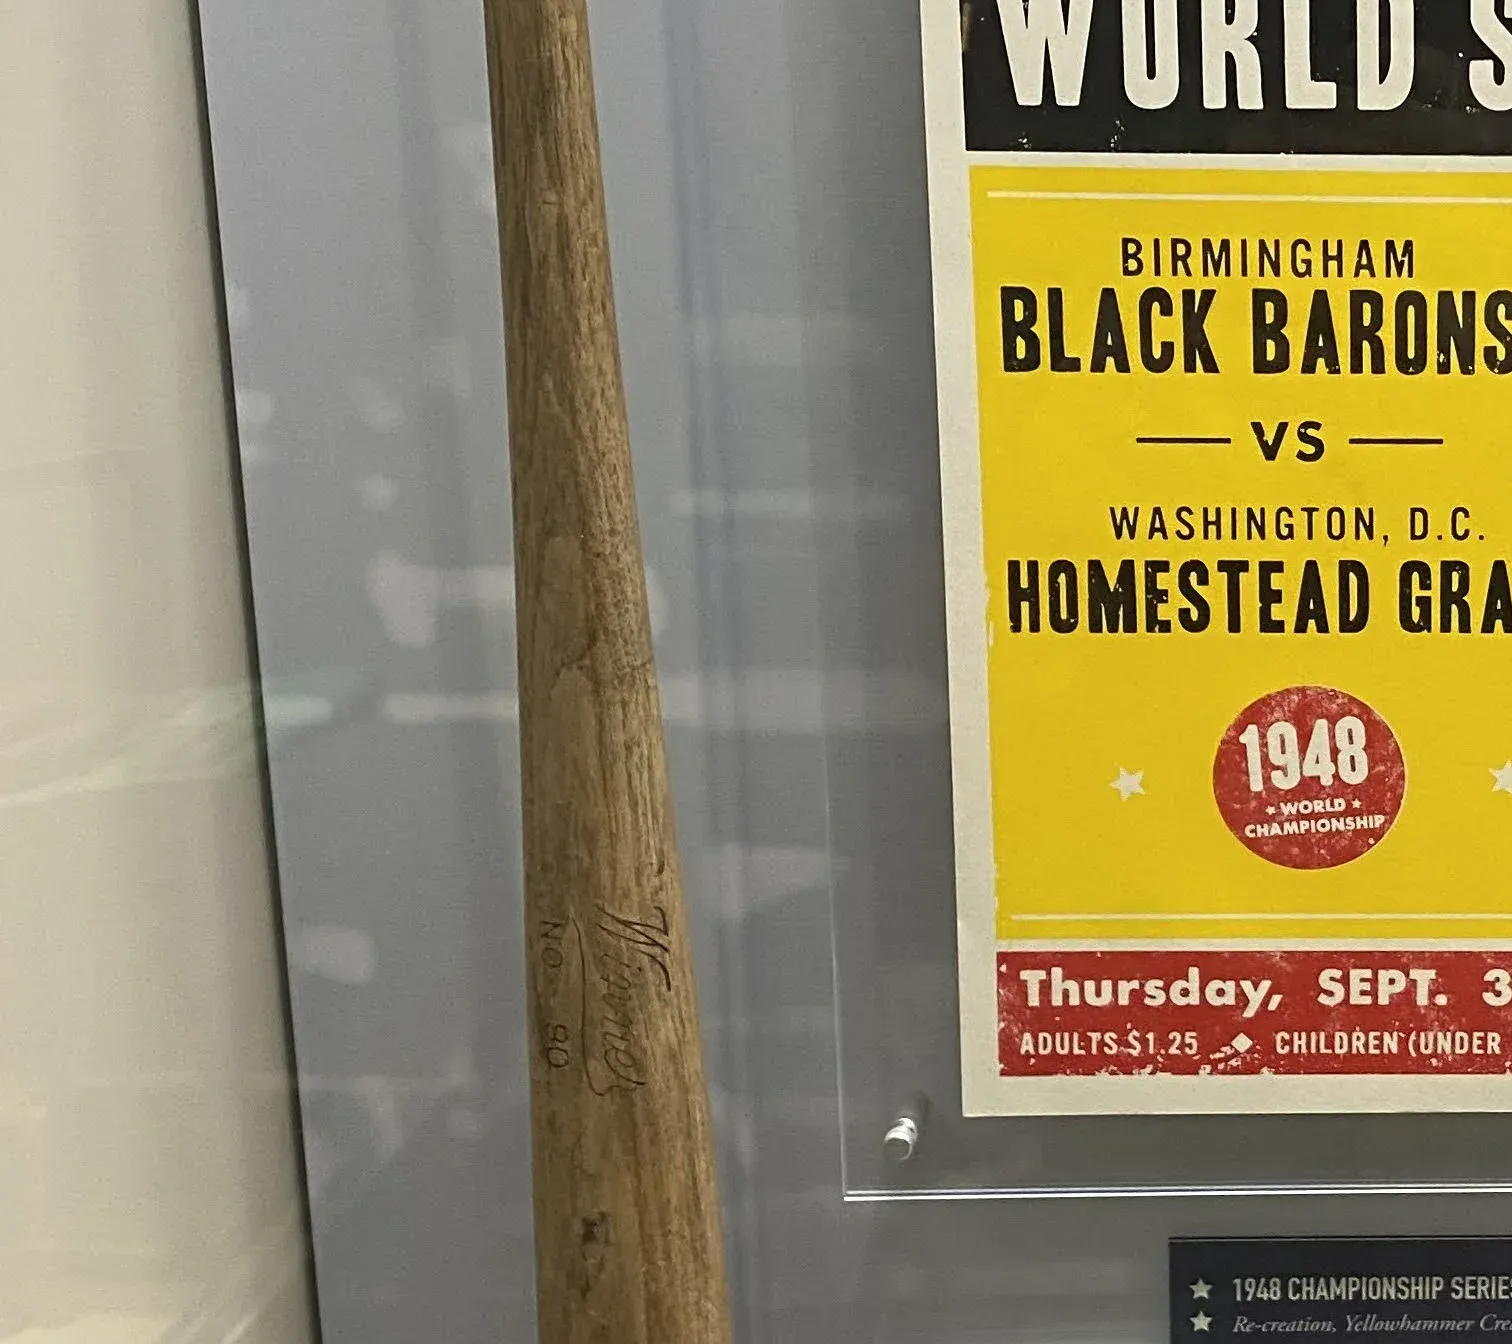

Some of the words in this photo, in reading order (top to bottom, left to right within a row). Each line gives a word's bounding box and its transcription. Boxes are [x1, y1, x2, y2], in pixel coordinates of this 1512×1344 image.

[1122, 238, 1416, 277] BIRMINGHAM
[1001, 286, 1220, 375] BLACK
[1252, 421, 1326, 461] VS
[1111, 507, 1390, 547] WASHINGTON,
[1409, 509, 1487, 542] D.C.
[1008, 560, 1370, 634] HOMESTEAD
[1239, 715, 1370, 793] 1948
[1244, 813, 1385, 838] CHAMPIONSHIP
[1279, 798, 1346, 815] WORLD
[1020, 967, 1284, 1012] Thursday,
[1318, 967, 1448, 1007] SEPT.
[1020, 1031, 1117, 1055] ADULTS
[1123, 1030, 1200, 1056] $1.25
[1275, 1030, 1401, 1055] CHILDREN
[1408, 1030, 1503, 1058] (UNDER
[1232, 1278, 1281, 1301] 1948
[1287, 1276, 1444, 1301] CHAMPIONSHIP
[1232, 1315, 1337, 1335] Re-creation,
[1344, 1314, 1473, 1333] Yellowhammer
